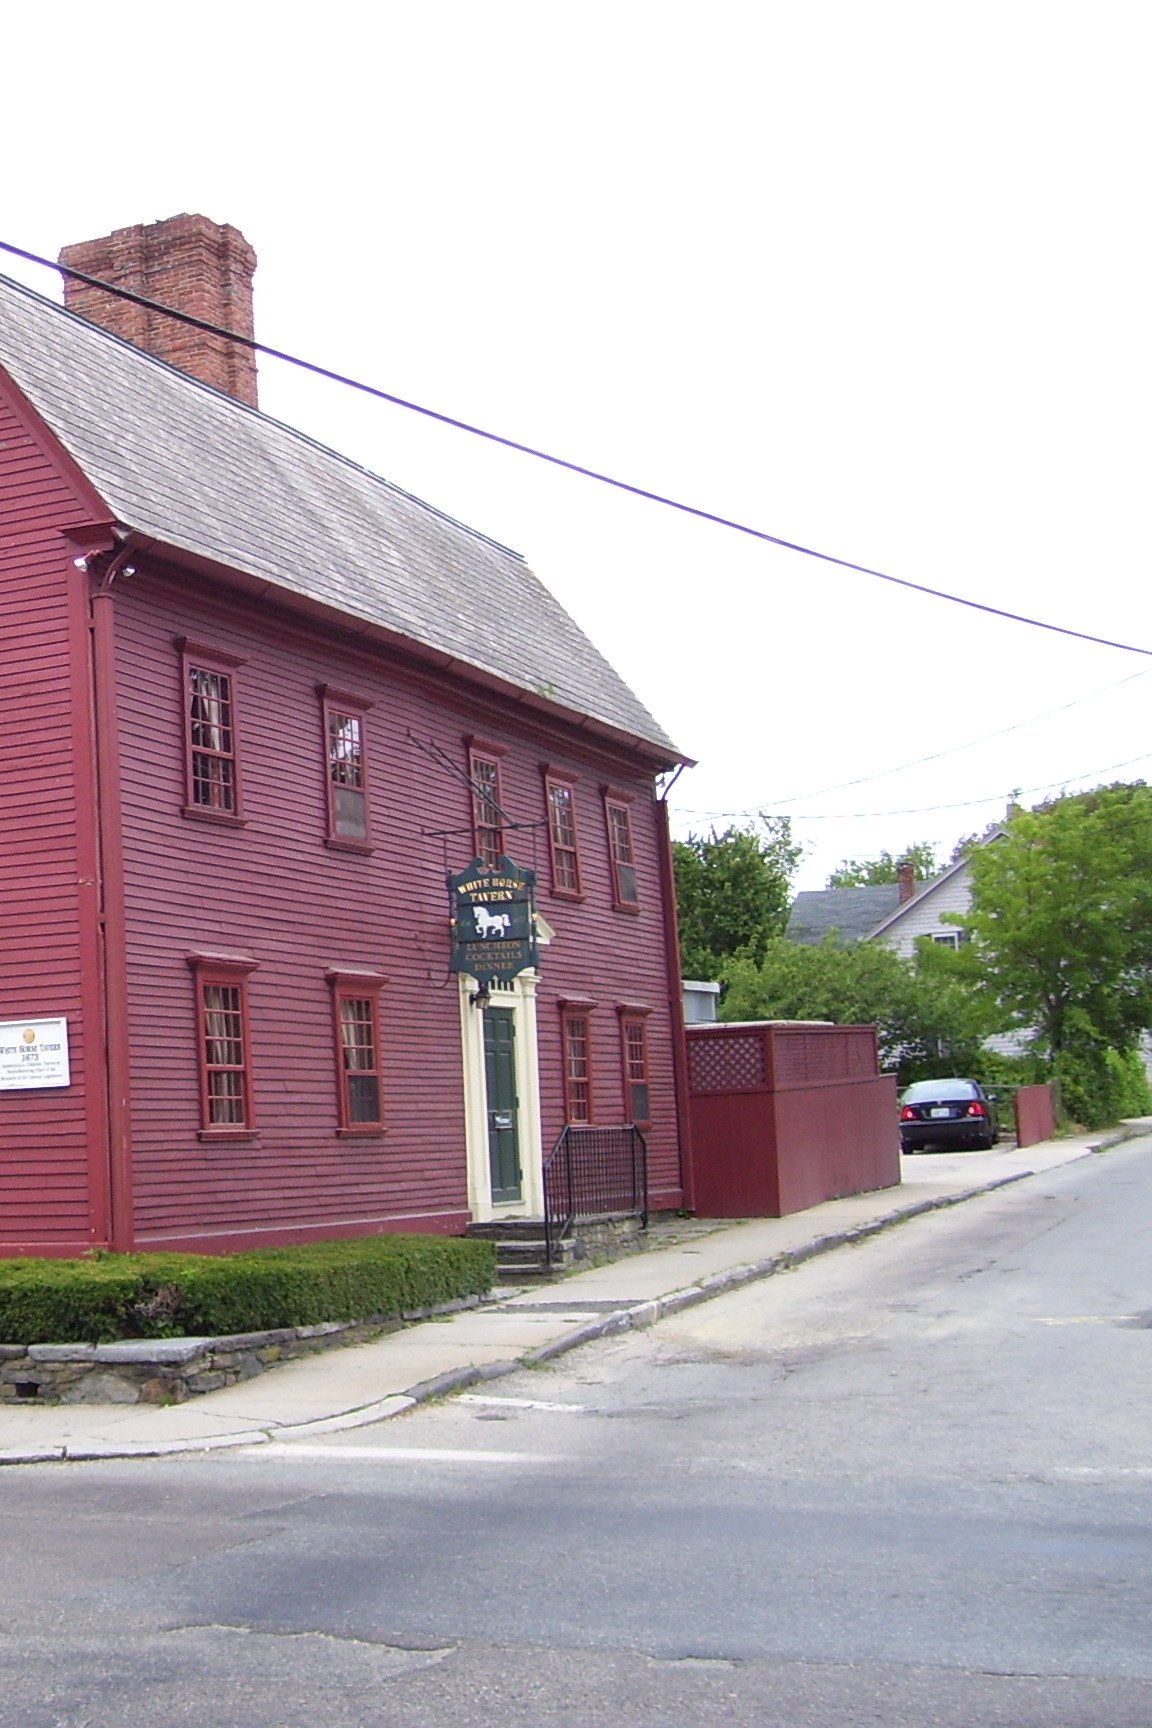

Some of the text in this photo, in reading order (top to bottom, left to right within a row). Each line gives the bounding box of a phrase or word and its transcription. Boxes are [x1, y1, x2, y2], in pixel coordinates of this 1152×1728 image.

[457, 877, 526, 894] WHITE HORSE
[469, 890, 514, 902] TAVERN
[466, 940, 520, 951] LUNCHEON
[465, 951, 523, 961] COCKTAILS
[474, 962, 515, 972] DINNER
